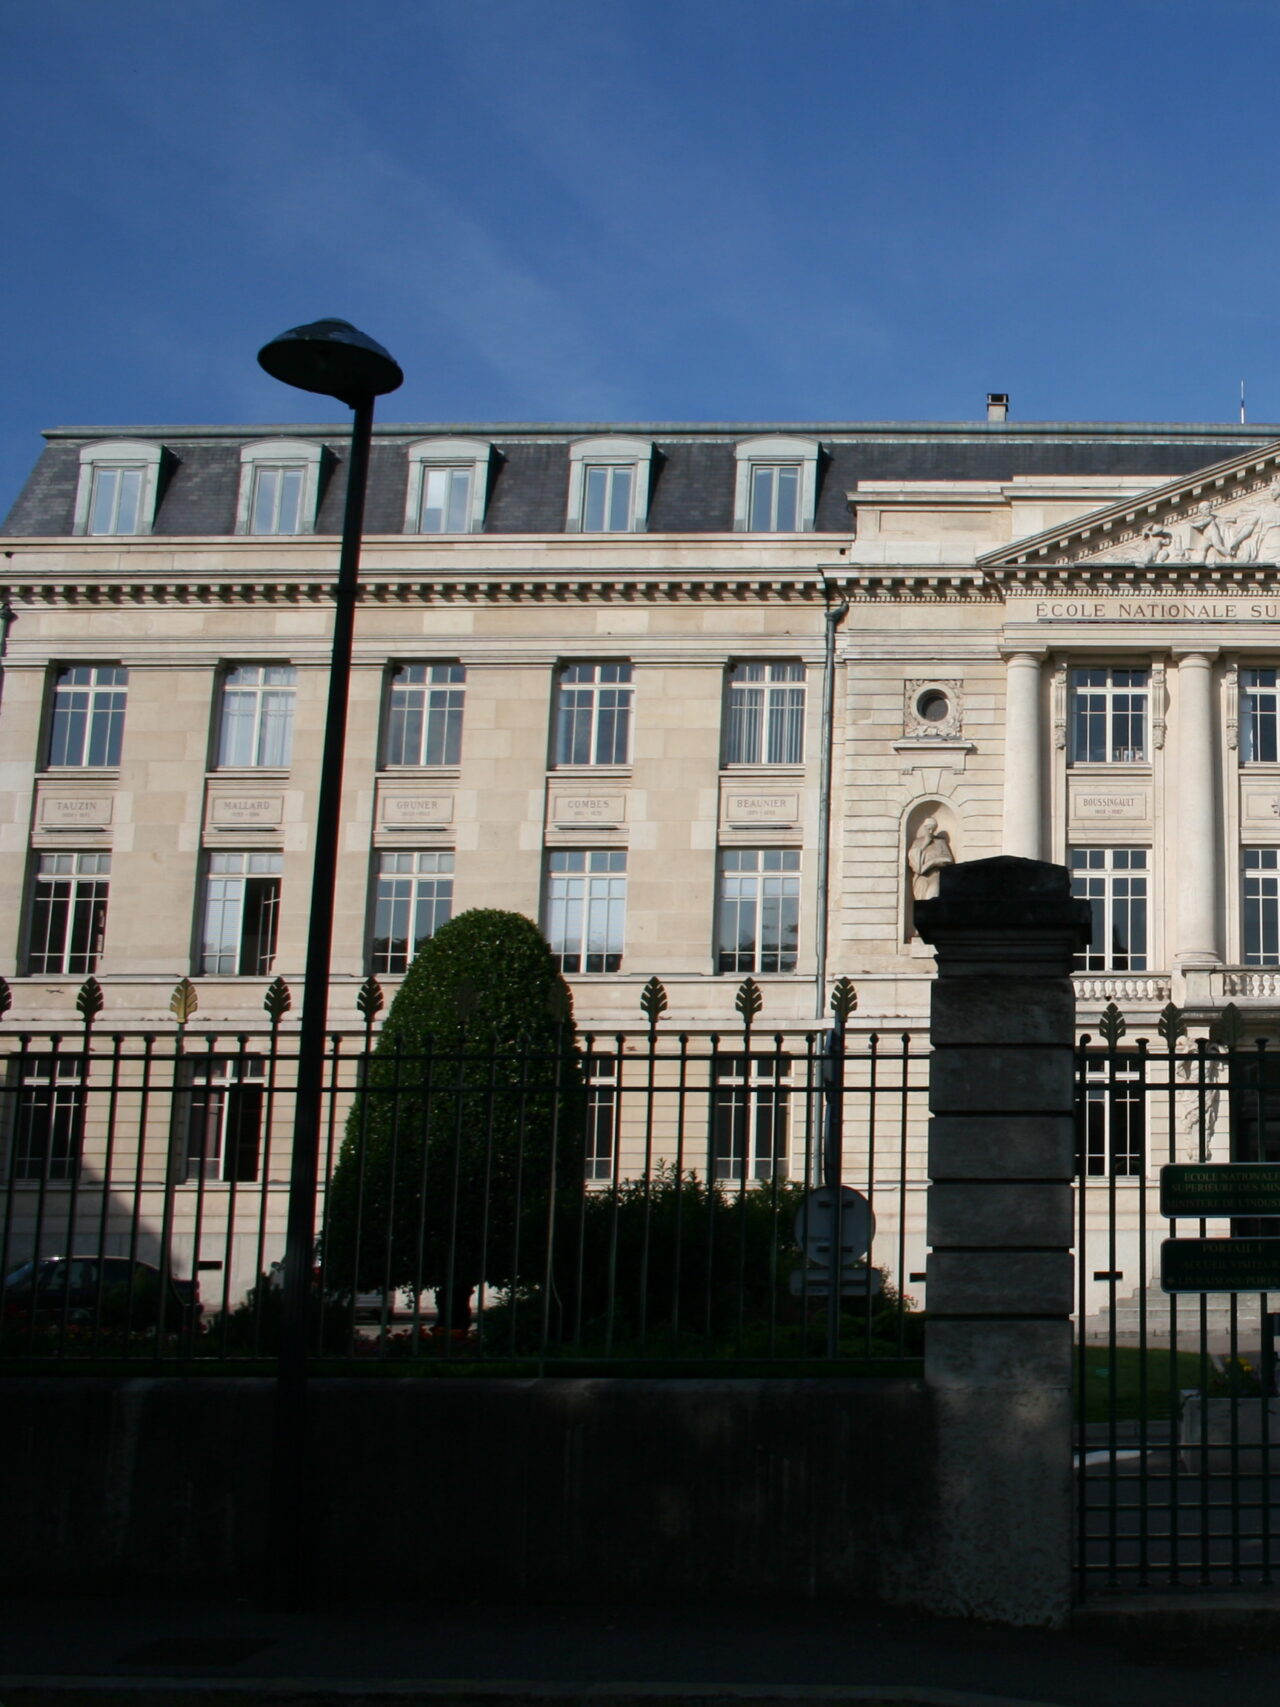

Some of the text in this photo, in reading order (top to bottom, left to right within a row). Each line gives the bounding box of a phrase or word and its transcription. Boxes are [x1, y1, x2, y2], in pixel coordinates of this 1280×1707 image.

[1035, 602, 1106, 618] ÉCOLE
[1119, 603, 1237, 619] NATIONALE
[56, 801, 97, 811] TAUZIN
[223, 800, 271, 811] MALLARD
[396, 800, 439, 810] GRUNER
[567, 799, 609, 809] COMBES
[736, 799, 787, 809] BEAUNIER
[1082, 797, 1135, 808] BOUSSINGAULT
[1183, 1172, 1280, 1182] ECOLE NATIONALE
[1171, 1182, 1235, 1193] SUPERIEURE
[1238, 1182, 1259, 1193] DES
